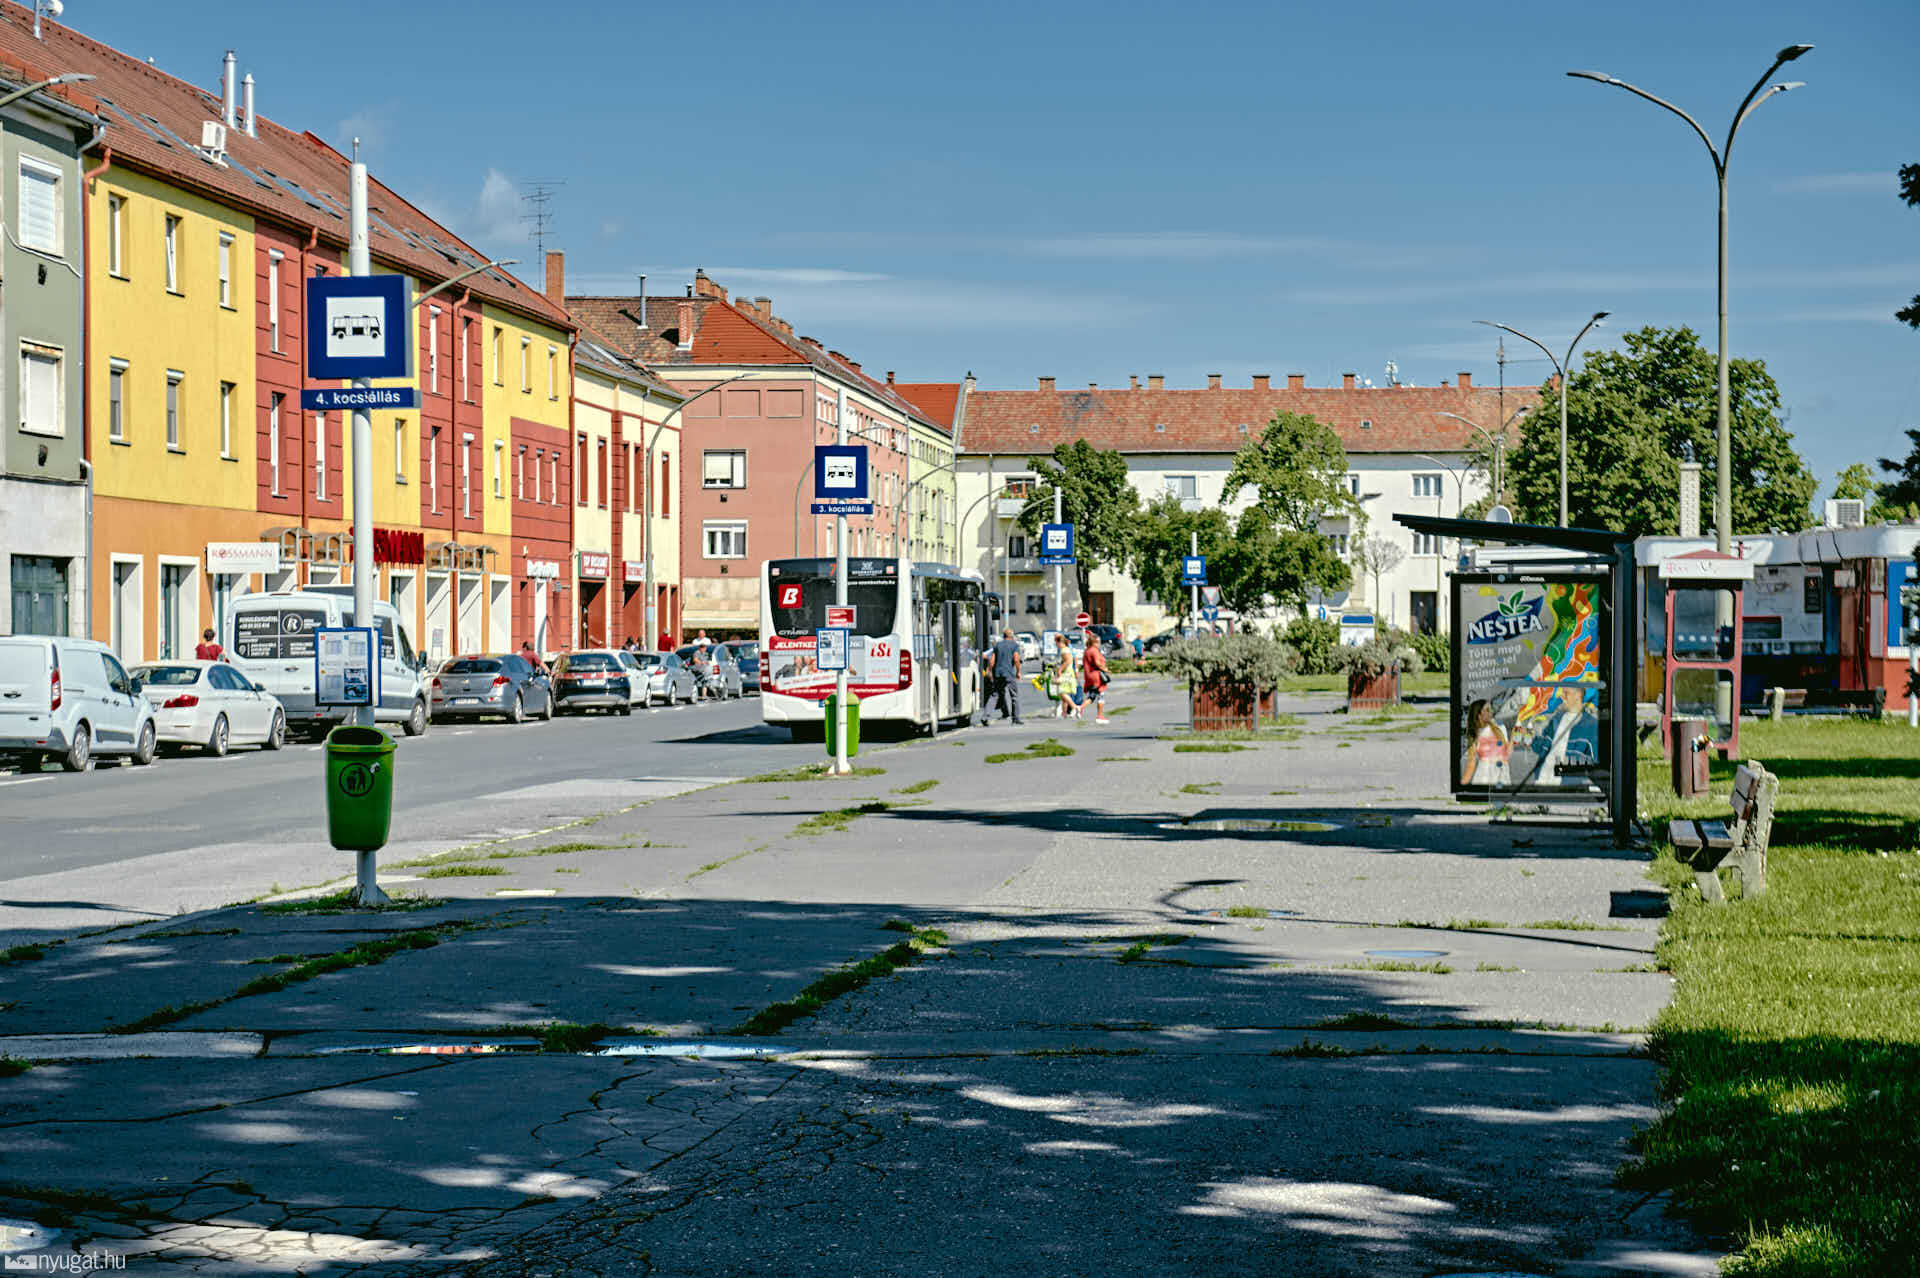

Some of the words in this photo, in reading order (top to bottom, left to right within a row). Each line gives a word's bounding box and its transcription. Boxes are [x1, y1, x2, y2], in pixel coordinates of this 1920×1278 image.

[315, 393, 329, 405] 4.
[333, 390, 401, 405] kocsiállás
[818, 505, 827, 513] 3.
[211, 548, 273, 559] ROSSMANN
[1468, 614, 1543, 640] NESTEA
[1497, 644, 1522, 655] meg
[1468, 655, 1517, 669] örömel
[1468, 666, 1510, 680] minden
